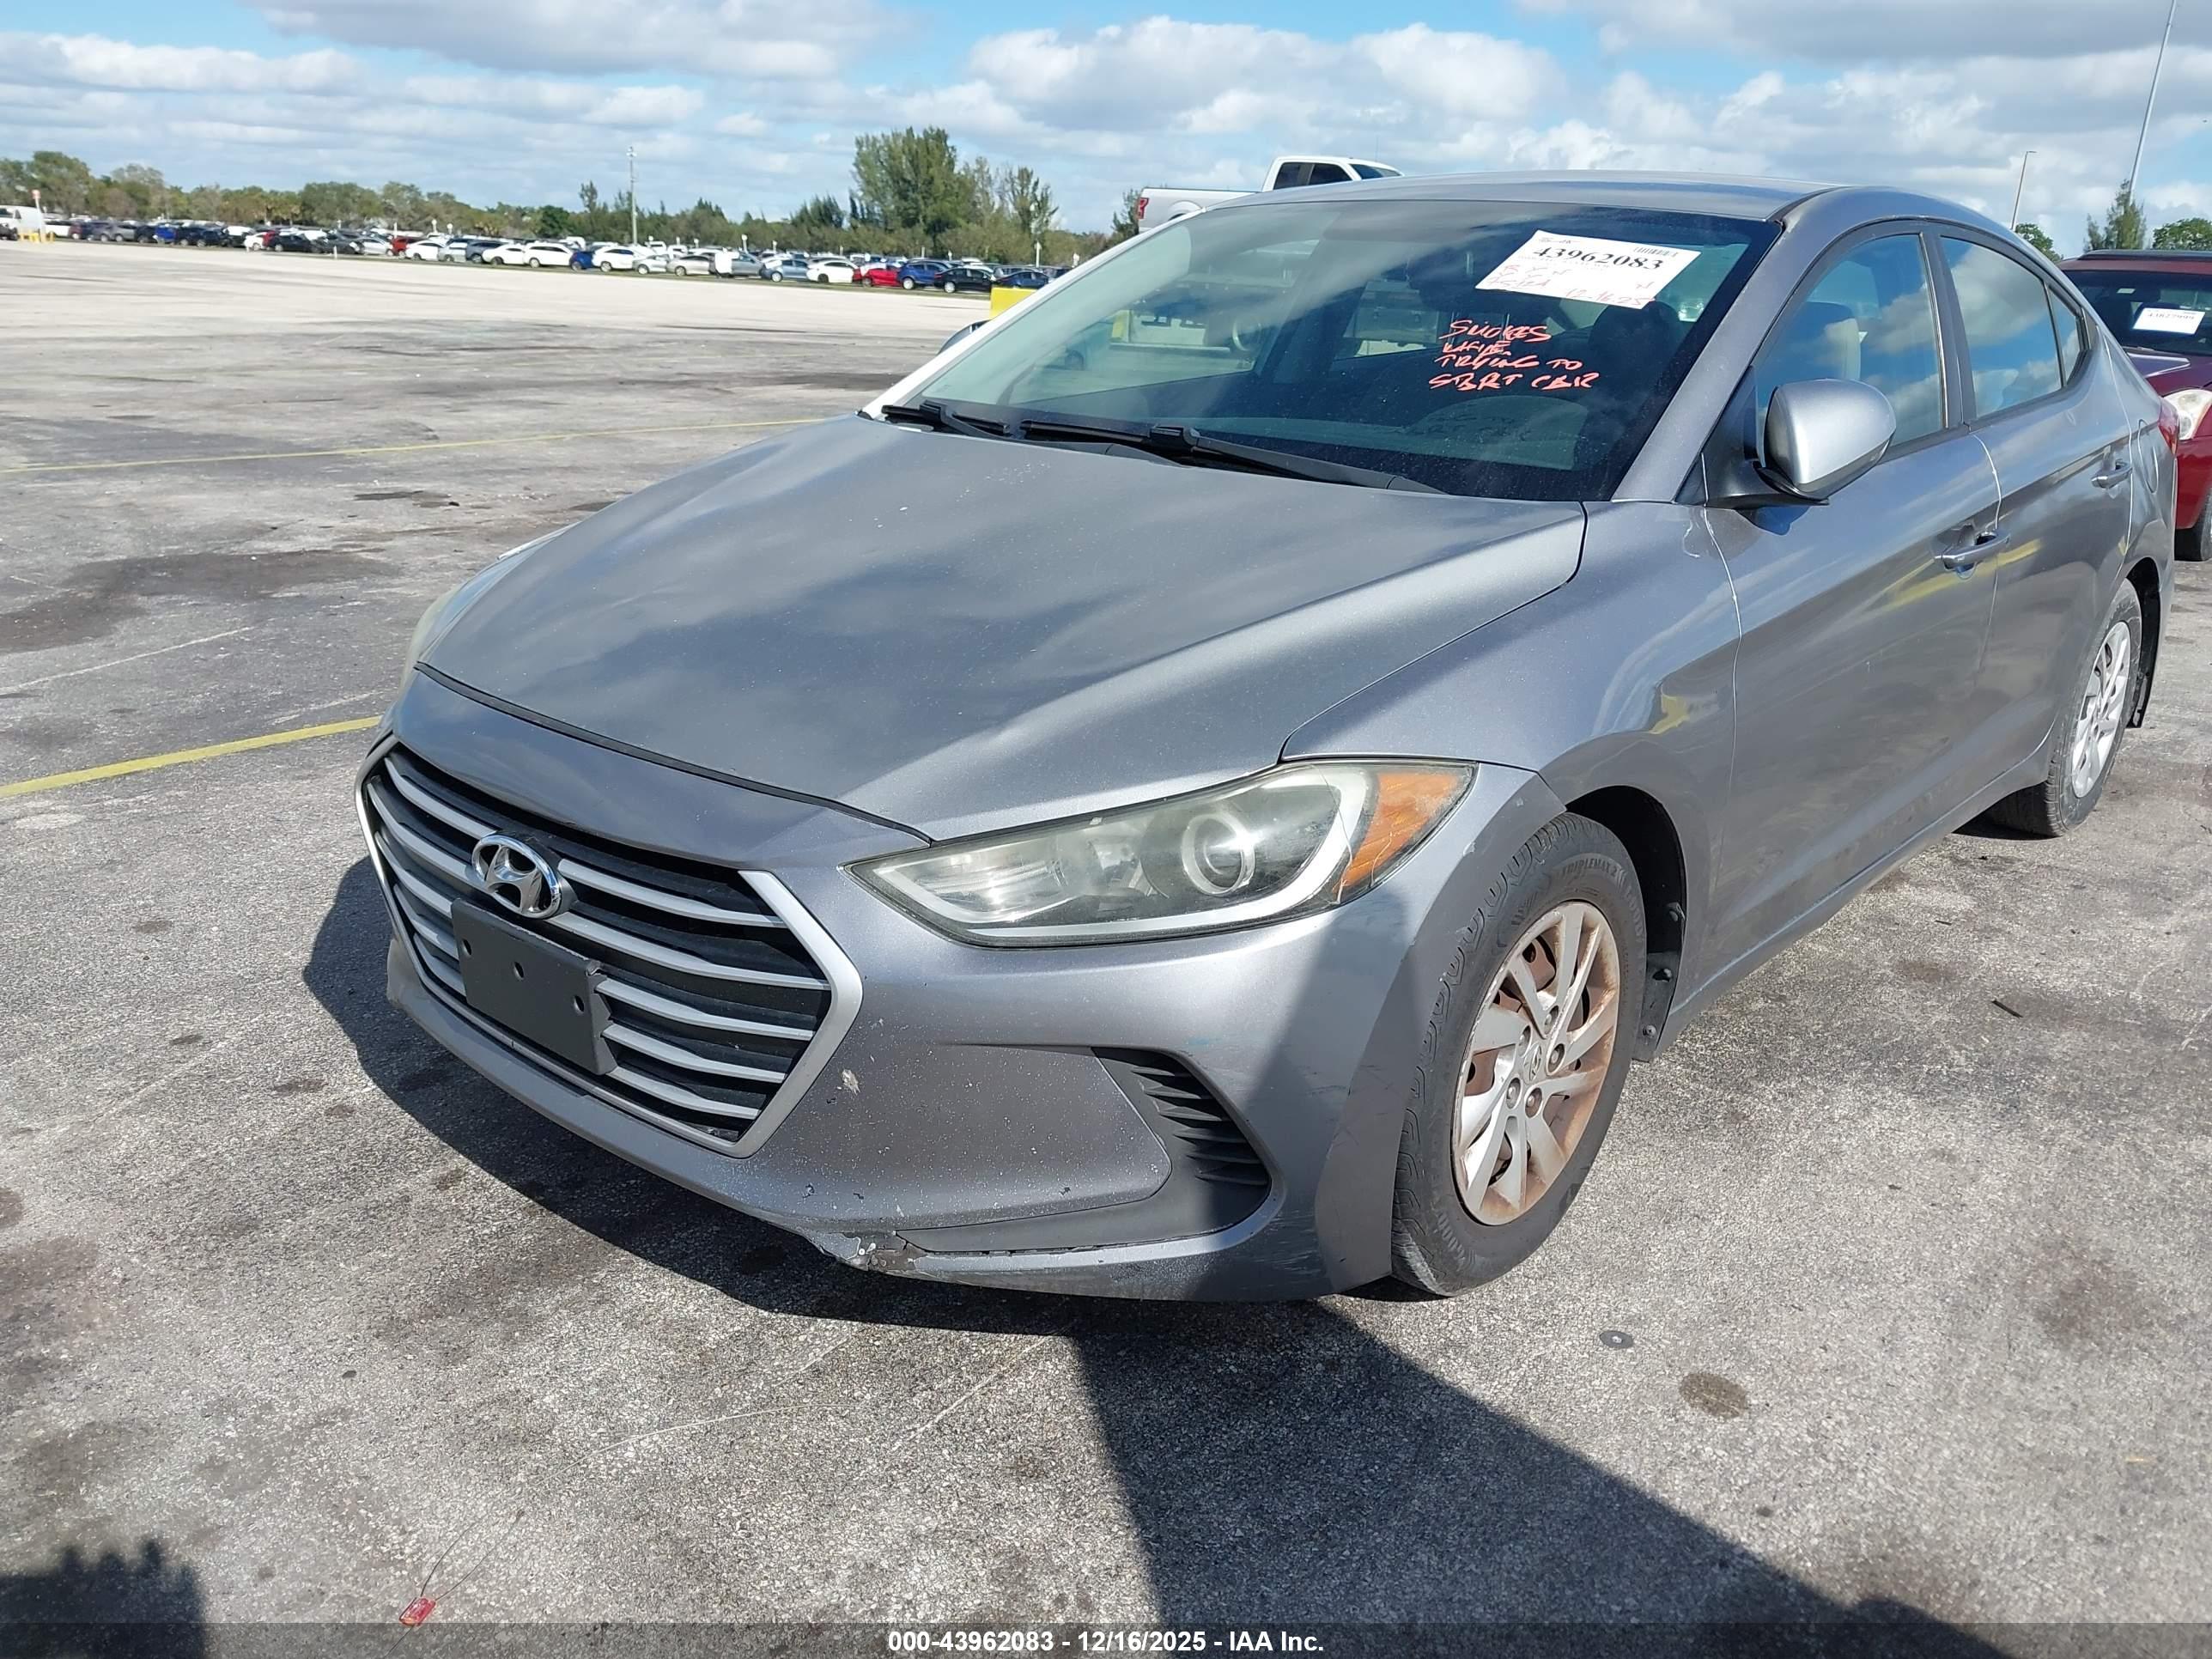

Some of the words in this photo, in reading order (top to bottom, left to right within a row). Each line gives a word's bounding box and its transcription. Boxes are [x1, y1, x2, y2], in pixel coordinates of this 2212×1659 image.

[1533, 246, 1663, 270] 43962083
[1434, 354, 1540, 370] TRYING
[1546, 358, 1583, 370] TO
[1428, 372, 1523, 391] START
[1531, 372, 1600, 391] CAR
